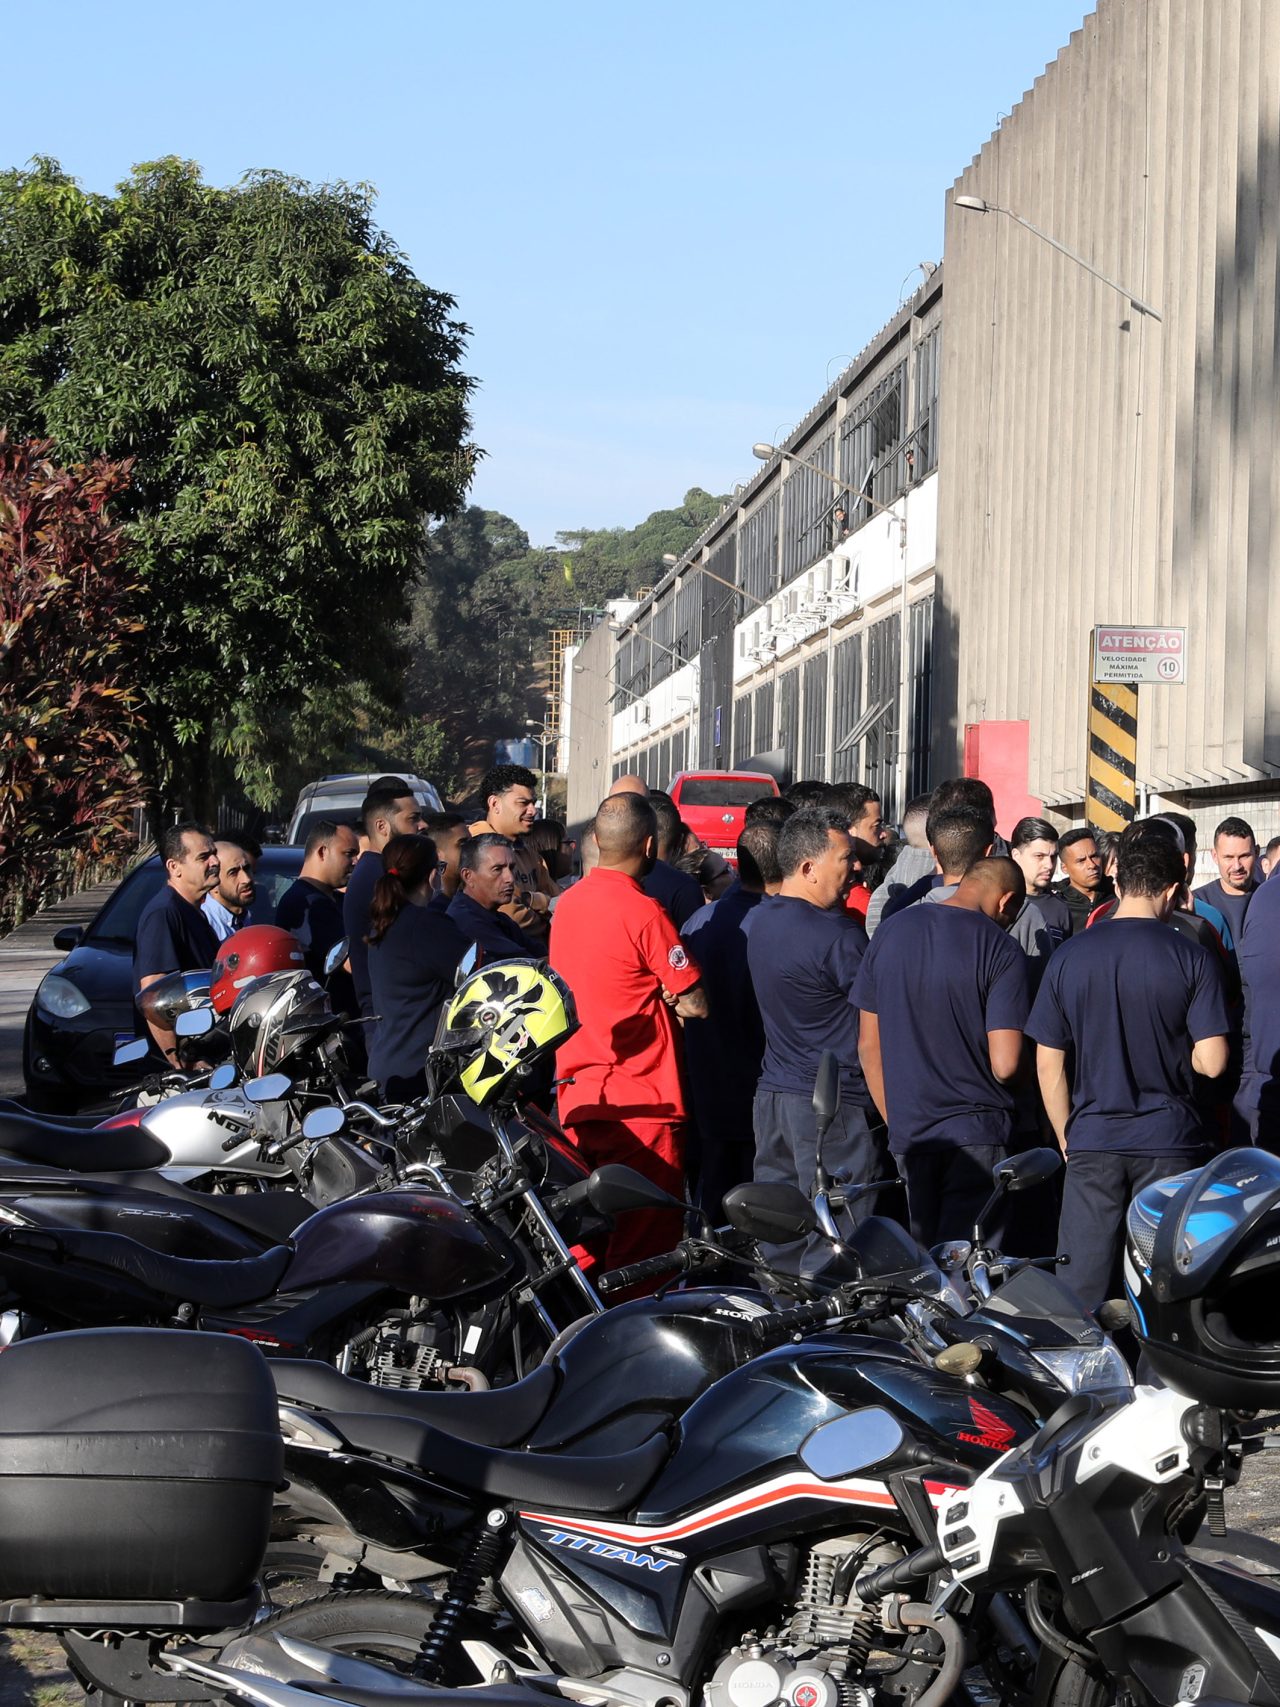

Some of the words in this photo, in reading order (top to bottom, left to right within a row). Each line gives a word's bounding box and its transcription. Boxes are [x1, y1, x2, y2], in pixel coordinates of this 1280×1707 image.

[1101, 634, 1180, 651] ATENÇÃO
[1109, 662, 1139, 670] MÁXIMA
[1162, 661, 1176, 673] 10
[715, 1308, 754, 1322] HON
[956, 1431, 1012, 1453] HONDA
[540, 1529, 681, 1573] TITAN
